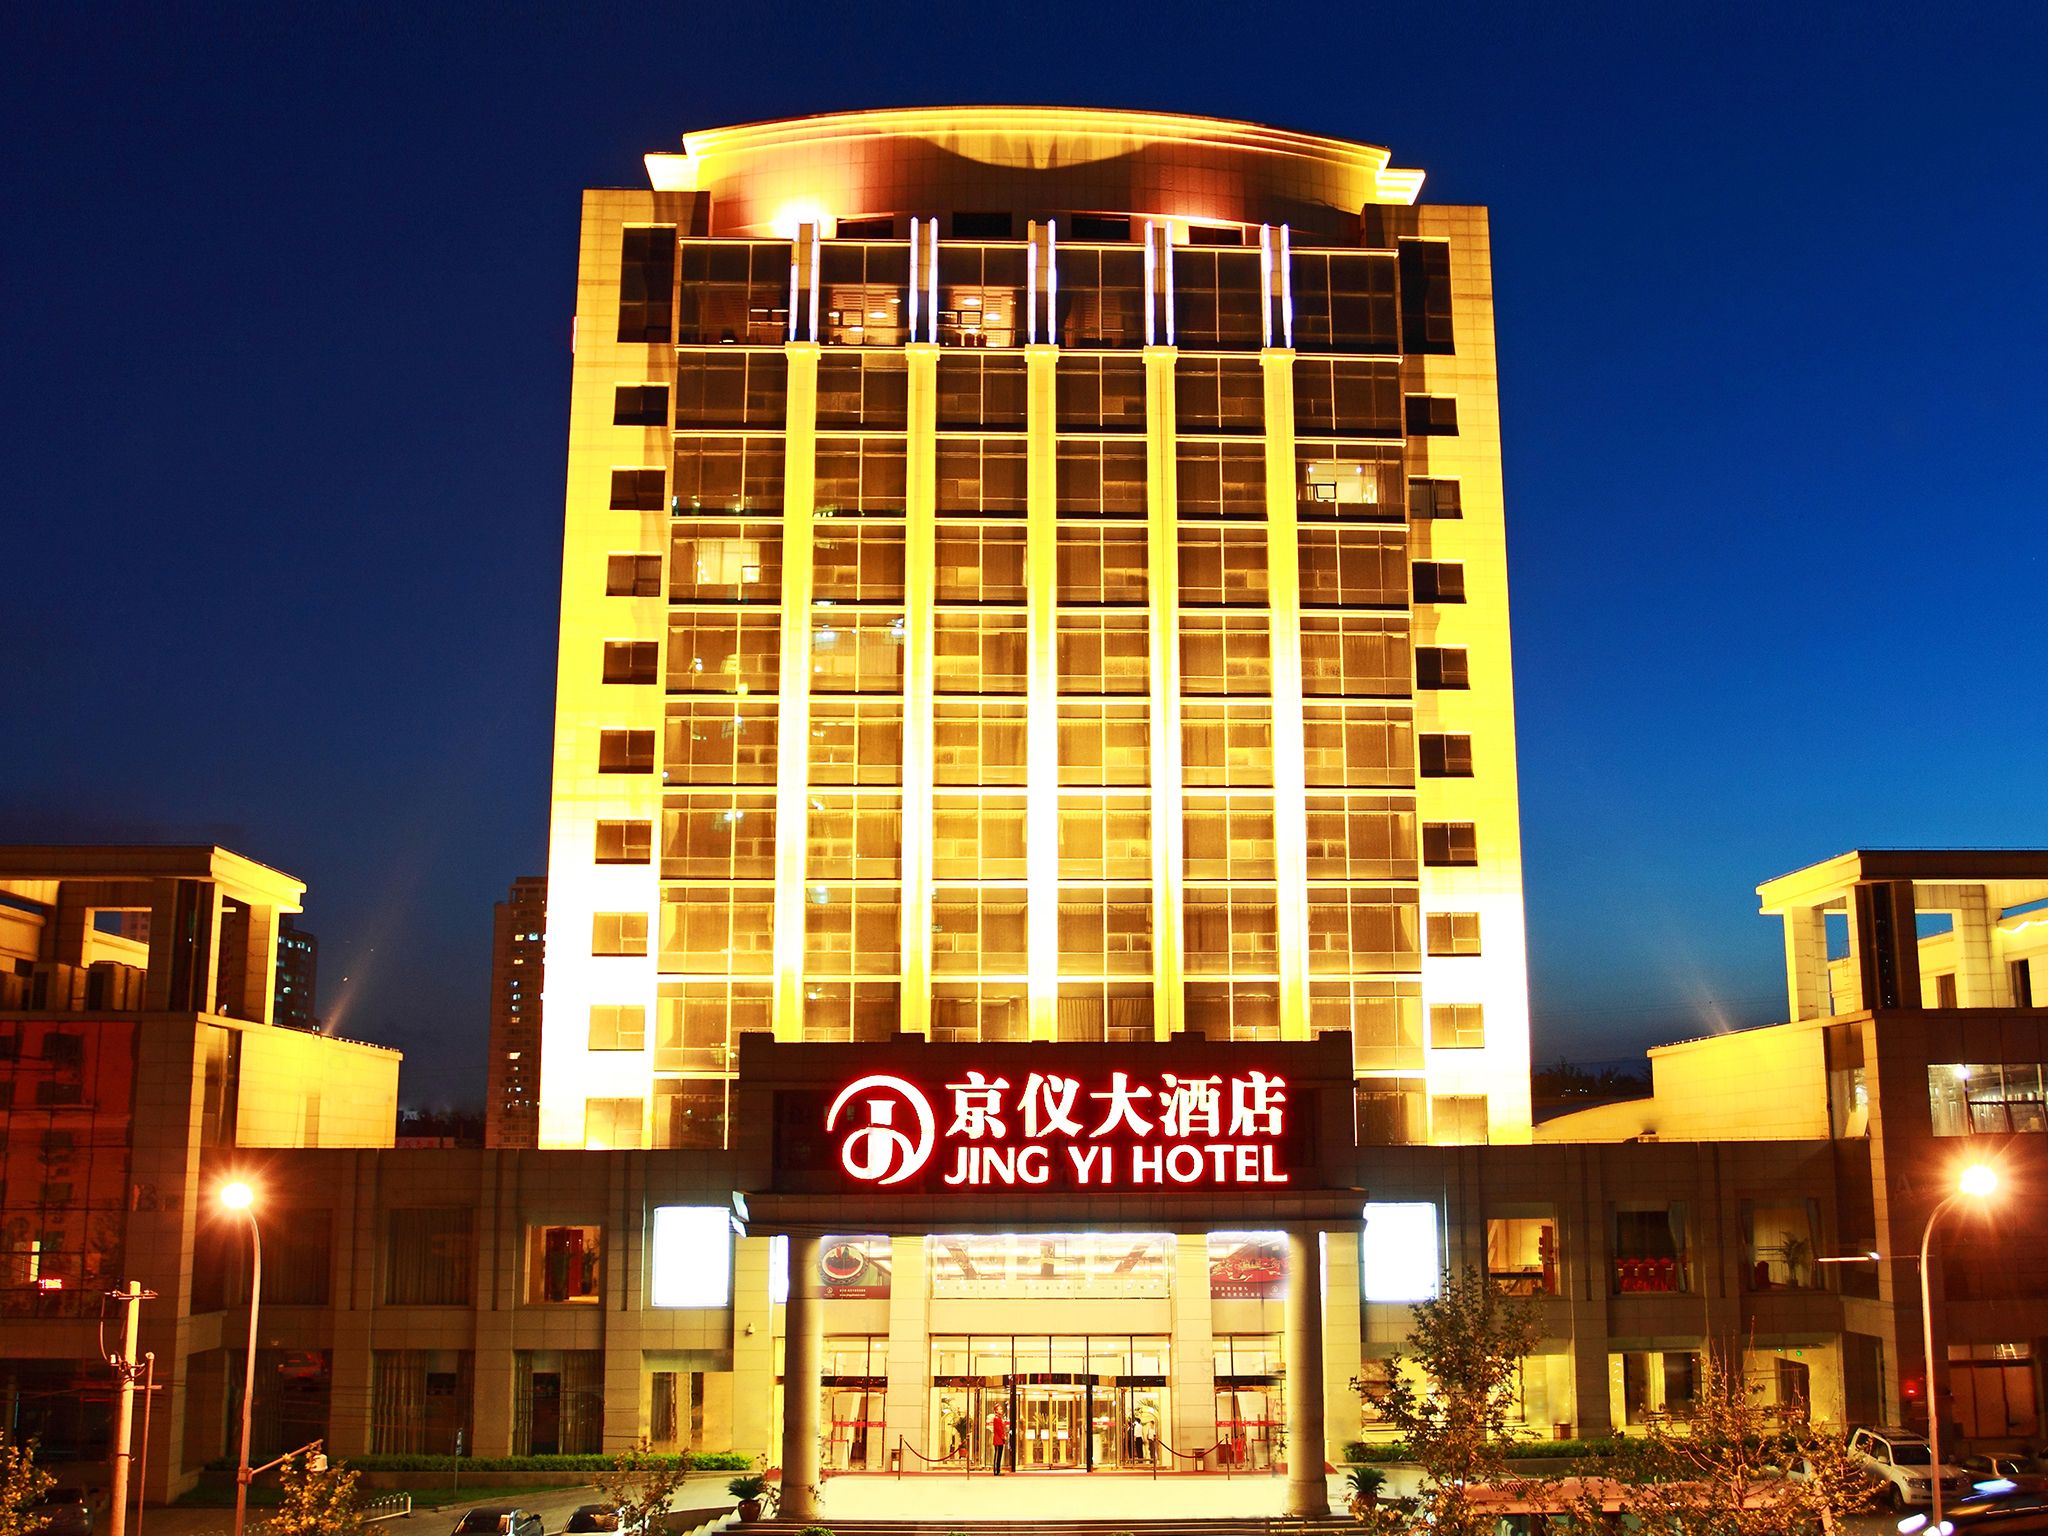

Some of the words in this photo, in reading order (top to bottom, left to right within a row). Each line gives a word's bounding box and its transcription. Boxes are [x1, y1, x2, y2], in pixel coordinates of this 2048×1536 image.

[944, 1070, 1287, 1139] 京仪大酒店
[944, 1145, 1049, 1185] JING
[1067, 1145, 1113, 1185] YI
[1132, 1144, 1288, 1184] HOTEL
